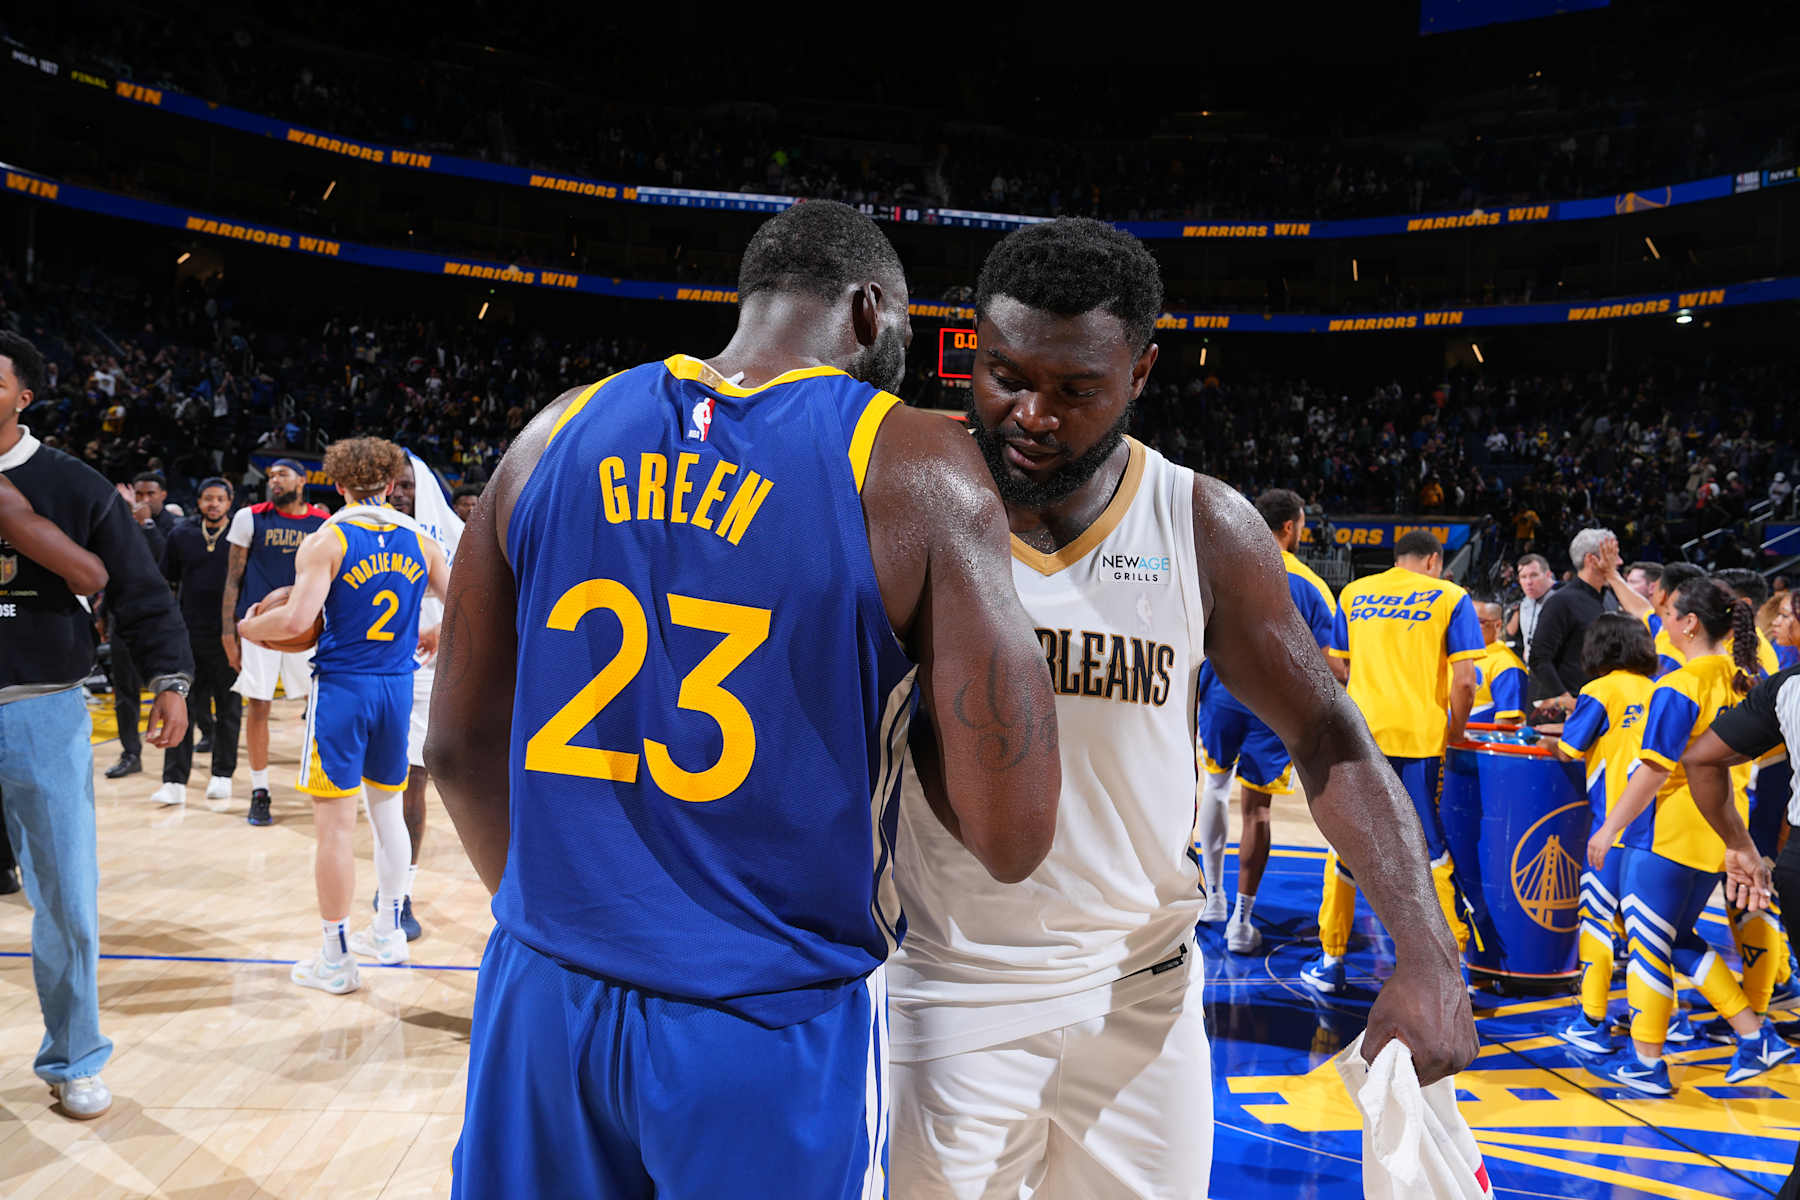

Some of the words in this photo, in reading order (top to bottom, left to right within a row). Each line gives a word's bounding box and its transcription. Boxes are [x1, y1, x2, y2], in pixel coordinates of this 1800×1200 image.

[116, 82, 162, 105] WIN
[287, 128, 384, 163] WARRIORS
[391, 150, 432, 169] WIN
[6, 172, 59, 200] WIN
[529, 174, 617, 199] WARRIORS
[1183, 225, 1268, 237] WARRIORS
[1274, 223, 1311, 236] WIN
[1406, 211, 1501, 231] WARRIORS
[1508, 206, 1551, 222] WIN
[186, 216, 292, 248] WARRIORS
[299, 236, 341, 257] WIN
[443, 262, 535, 285] WARRIORS
[540, 271, 579, 288] WIN
[1567, 299, 1671, 321] WARRIORS
[1678, 289, 1726, 309] WIN
[1193, 315, 1230, 329] WIN
[1328, 316, 1417, 332] WARRIORS
[1423, 311, 1463, 326] WIN
[599, 452, 774, 546] GREEN
[264, 527, 308, 547] PELICA
[1394, 525, 1450, 545] WN
[342, 551, 425, 590] PODZIEMSKI
[1114, 571, 1159, 582] GRILLS
[1352, 594, 1404, 608] DUB
[366, 589, 399, 641] 2
[1350, 606, 1432, 622] SQUAD
[524, 578, 772, 803] 23
